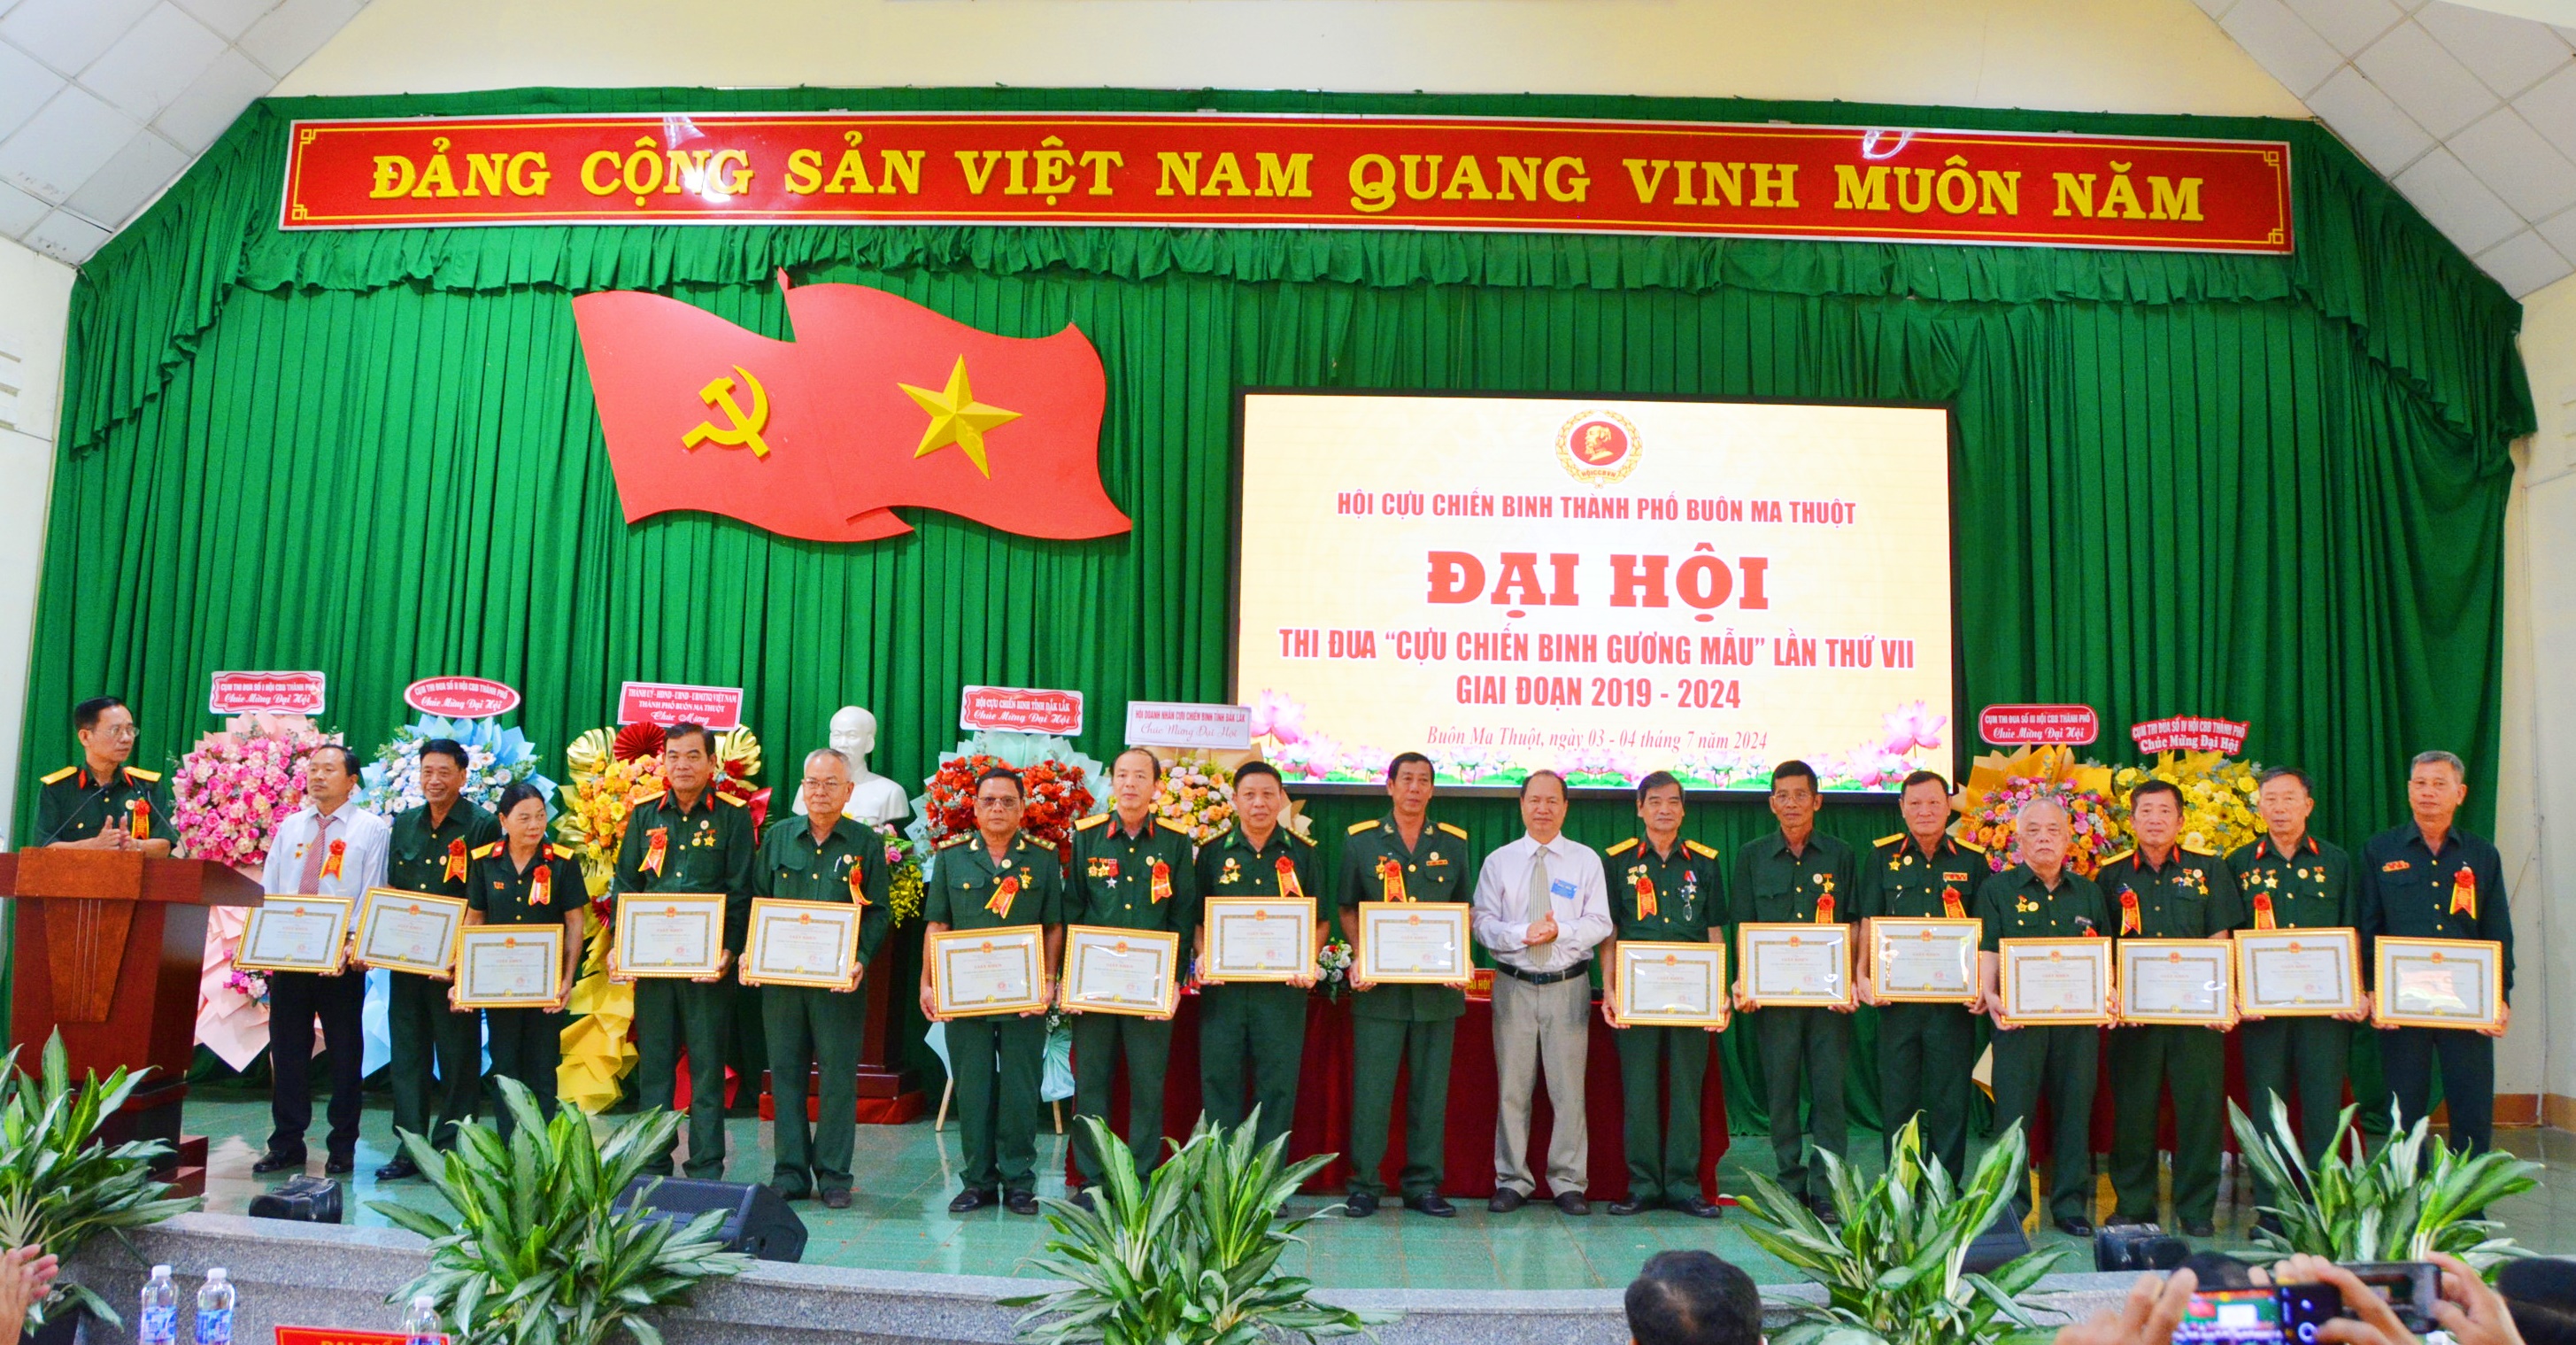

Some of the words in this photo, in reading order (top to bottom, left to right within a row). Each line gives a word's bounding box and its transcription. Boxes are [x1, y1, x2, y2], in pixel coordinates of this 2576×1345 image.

[370, 137, 551, 200] ĐẢNG
[580, 135, 754, 207] CỘNG
[783, 130, 925, 196] SẢN
[954, 135, 1124, 206] VIỆT
[1155, 151, 1314, 197] NAM
[1349, 154, 1590, 213] QUANG
[1622, 158, 1800, 208] VINH
[1833, 155, 2022, 215] MUÔN
[2052, 160, 2204, 221] NĂM
[1338, 491, 1374, 518] HỘI
[1382, 491, 1424, 518] CỰU
[1432, 487, 1495, 517] CHIẾN
[1502, 496, 1553, 518] BINH
[1561, 491, 1630, 520] THÀNH
[1638, 491, 1678, 521] PHỐ
[1687, 496, 1743, 522] BUÔN
[1751, 500, 1783, 523] MA
[1790, 498, 1856, 528] THUỘT
[1427, 551, 1579, 619] ĐẠI
[1609, 542, 1769, 622] HỘI
[1279, 630, 1319, 658] THI
[1328, 630, 1377, 659] ĐUA
[1385, 627, 1446, 666] “CỰU
[1456, 622, 1529, 661] CHIẾN
[1539, 633, 1598, 663] BINH
[1607, 632, 1691, 665] GƯƠNG
[1701, 626, 1765, 667] MẪU”
[1774, 630, 1816, 667] LẦN
[1825, 633, 1876, 669] THỨ
[1881, 639, 1914, 669] VII
[1456, 676, 1506, 705] GIAI
[1516, 676, 1582, 712] ĐOẠN
[1591, 676, 1652, 707] 2019
[1677, 678, 1741, 709] 2024
[974, 710, 997, 721] Chúc
[1029, 712, 1048, 723] Đại
[1050, 714, 1071, 724] Hội
[1999, 715, 2008, 723] THI
[2148, 723, 2158, 735] THI
[1427, 726, 1465, 746] Buôn
[1471, 727, 1493, 746] Ma
[1500, 727, 1546, 750] Thuột,
[1549, 731, 1584, 747] ngày
[1588, 729, 1605, 747] 03
[1619, 730, 1636, 747] 04
[1640, 730, 1681, 752] tháng
[1687, 730, 1695, 748] 7
[1698, 732, 1728, 749] năm
[1733, 731, 1768, 750] 2024
[2045, 727, 2063, 740] Đại
[2065, 727, 2084, 740] Hội
[2201, 735, 2218, 749] Đại
[2220, 737, 2239, 753] Hội
